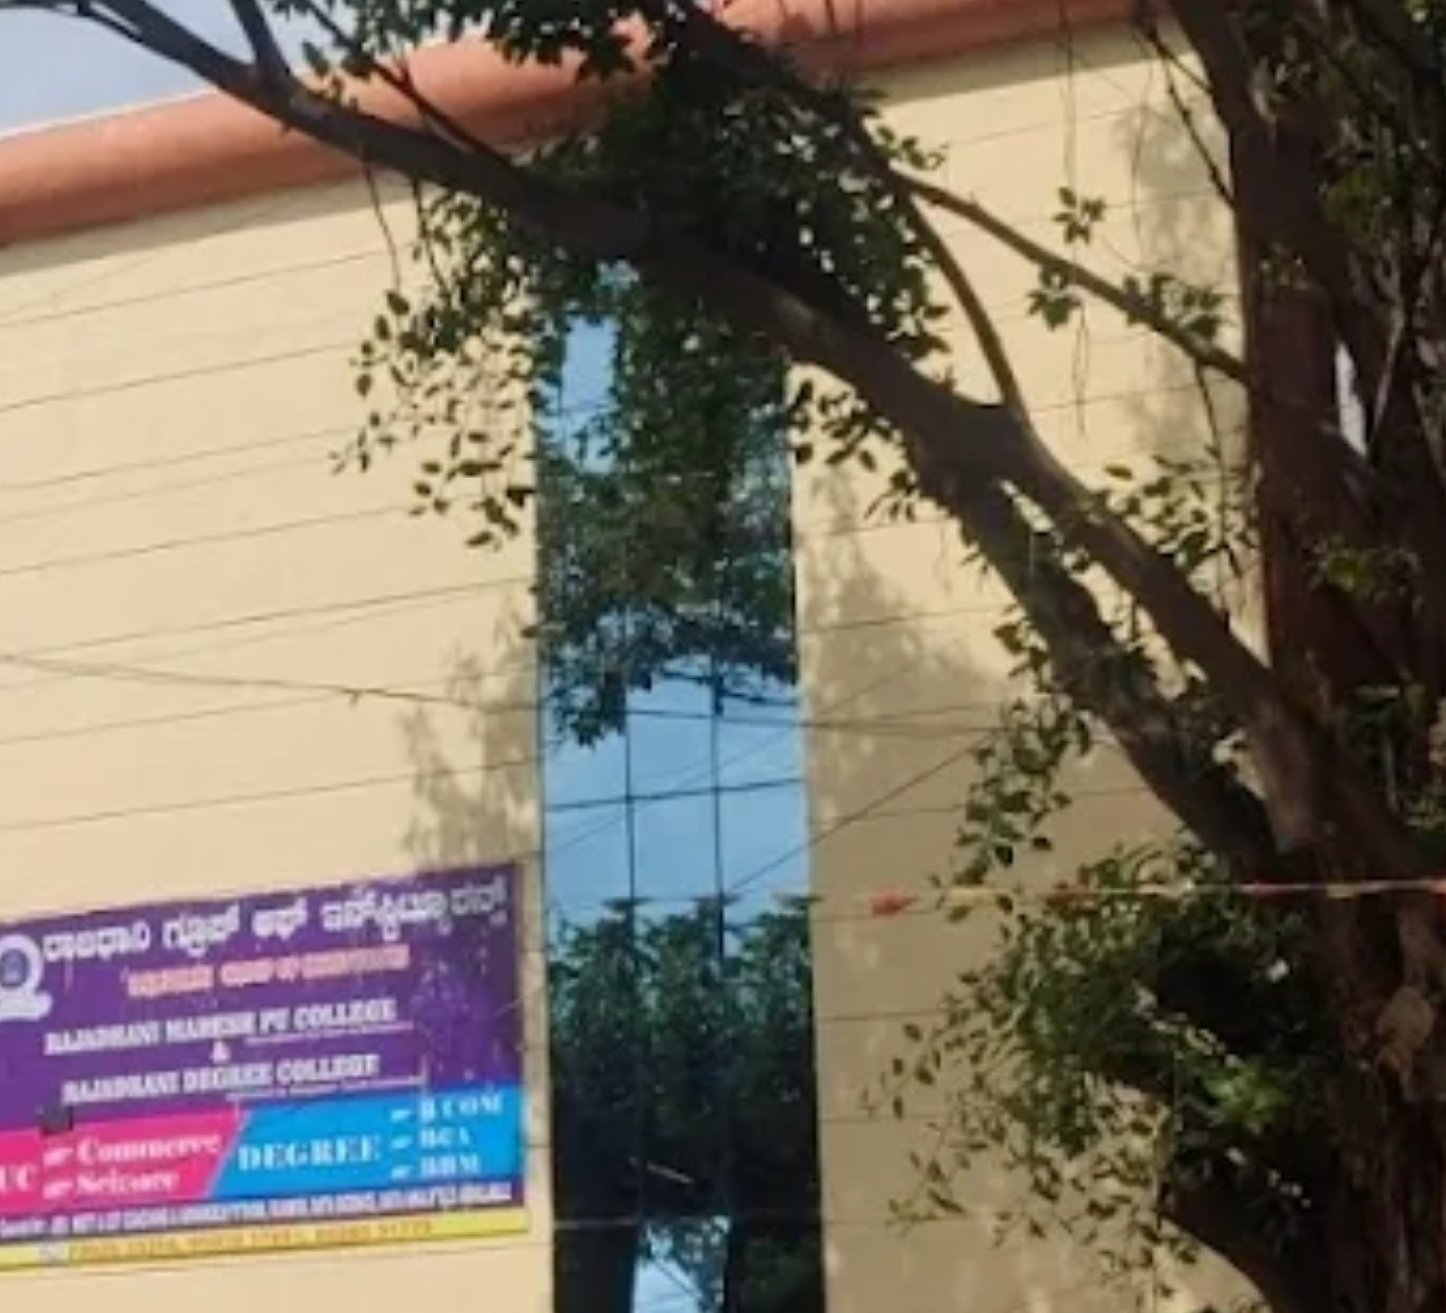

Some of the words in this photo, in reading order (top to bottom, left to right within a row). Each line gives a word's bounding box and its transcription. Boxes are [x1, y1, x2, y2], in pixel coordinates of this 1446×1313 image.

[293, 998, 398, 1030] COLLEGE
[182, 1062, 273, 1094] DEGREE
[276, 1053, 380, 1085] COLLEGE
[77, 1133, 222, 1166] Commerce
[238, 1133, 381, 1171] DEGREE
